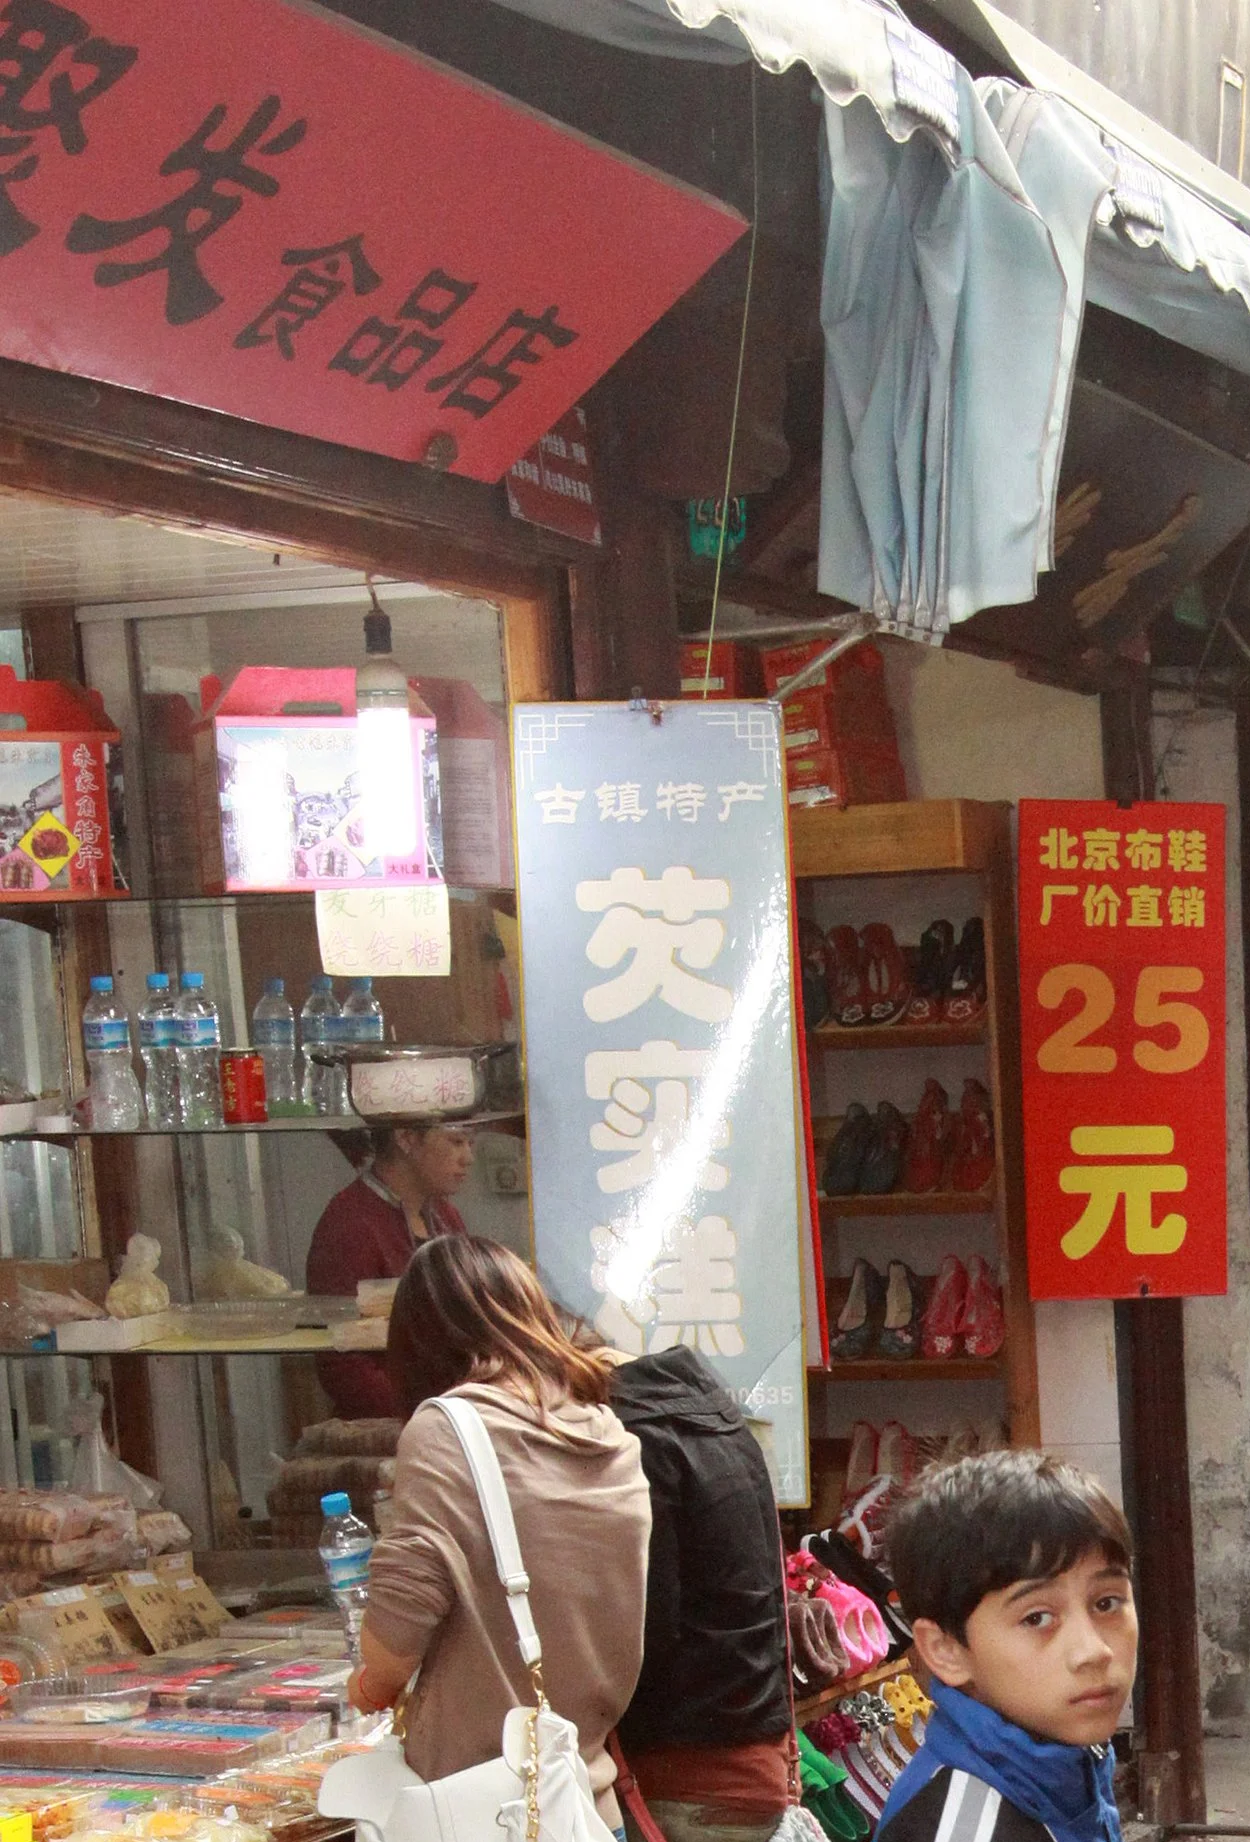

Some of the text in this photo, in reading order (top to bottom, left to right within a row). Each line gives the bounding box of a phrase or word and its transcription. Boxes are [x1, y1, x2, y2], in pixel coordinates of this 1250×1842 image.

[533, 781, 768, 825] 古镇特产
[1039, 828, 1207, 873] 北京布鞋
[1040, 884, 1205, 928] 厂价直销
[1037, 964, 1210, 1075] 25
[1060, 1126, 1187, 1260] 元
